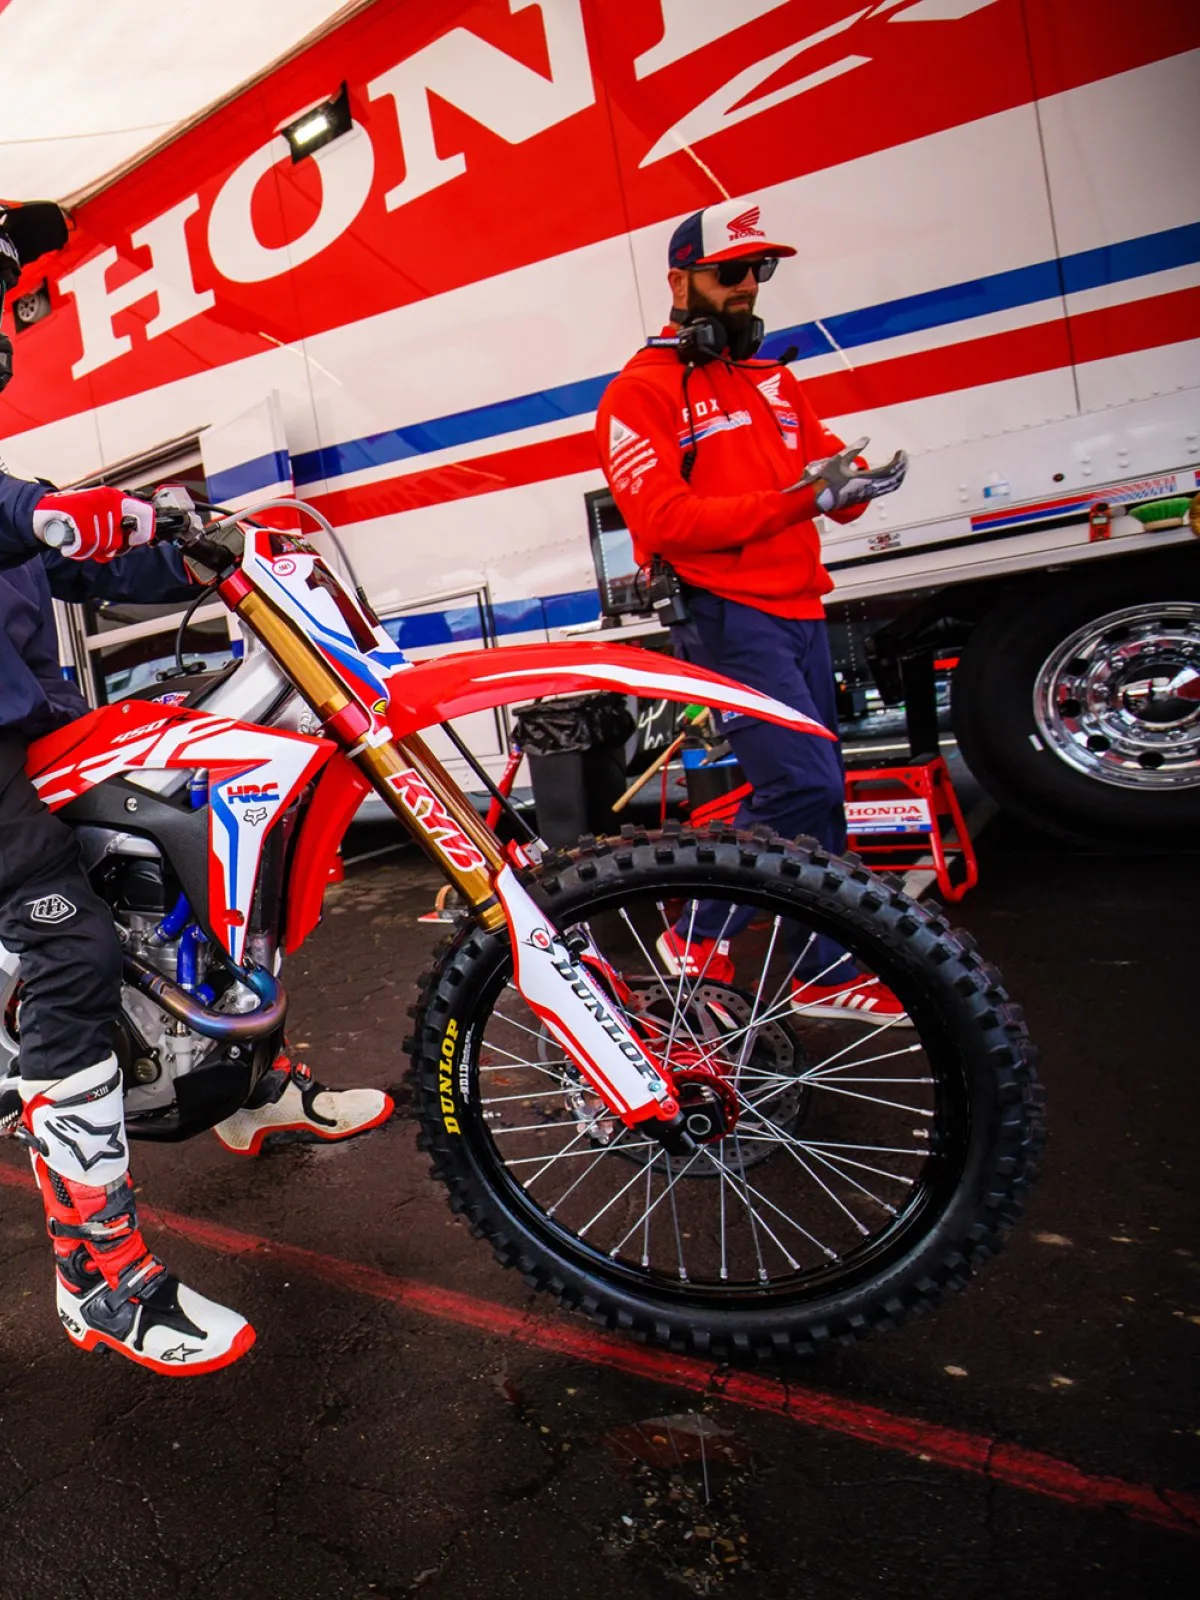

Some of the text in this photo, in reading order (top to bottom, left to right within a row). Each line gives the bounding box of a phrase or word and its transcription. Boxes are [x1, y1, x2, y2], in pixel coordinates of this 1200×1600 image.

[58, 0, 794, 380] HON
[682, 399, 720, 424] FOX
[226, 781, 280, 804] HRC
[384, 768, 486, 872] KYB
[848, 805, 922, 816] HONDA
[551, 958, 661, 1081] DUNLOP
[439, 1018, 461, 1135] DUNLOP
